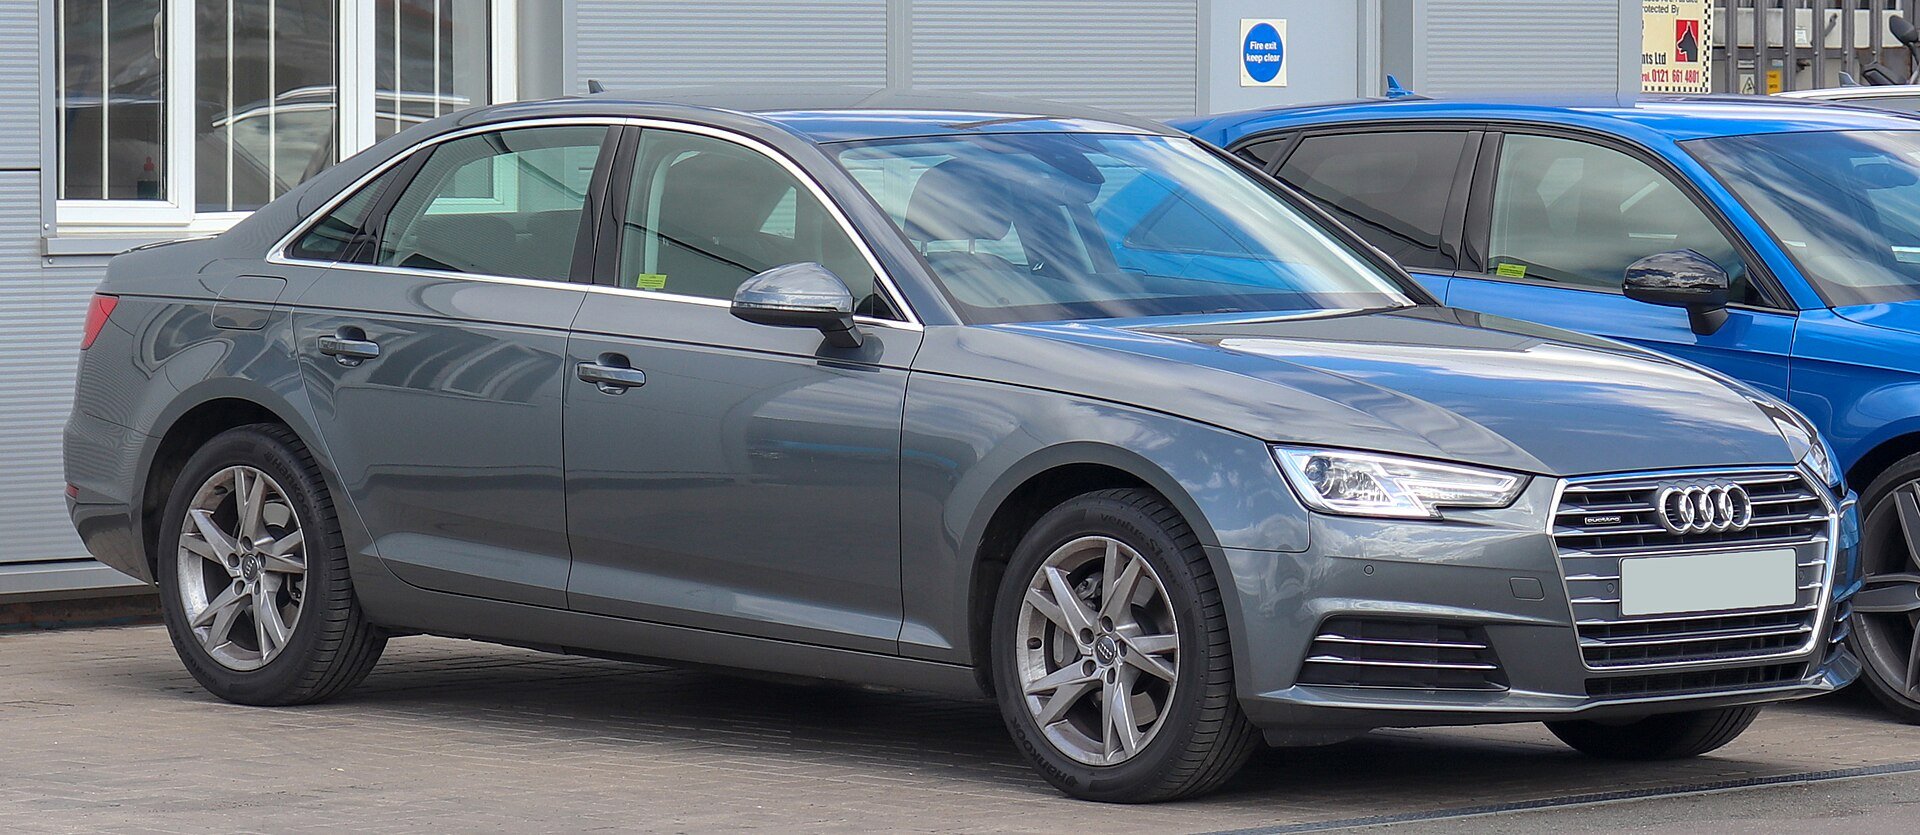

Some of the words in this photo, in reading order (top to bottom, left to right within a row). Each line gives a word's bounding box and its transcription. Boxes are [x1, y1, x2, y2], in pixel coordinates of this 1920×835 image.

[1671, 5, 1679, 15] By
[1250, 41, 1263, 50] Fire
[1265, 41, 1277, 50] exit
[1246, 53, 1263, 63] keep
[1264, 53, 1280, 62] clear
[1654, 52, 1666, 65] Ltd
[1652, 69, 1668, 82] 0121
[1672, 69, 1683, 83] 661
[1685, 70, 1699, 83] 4801
